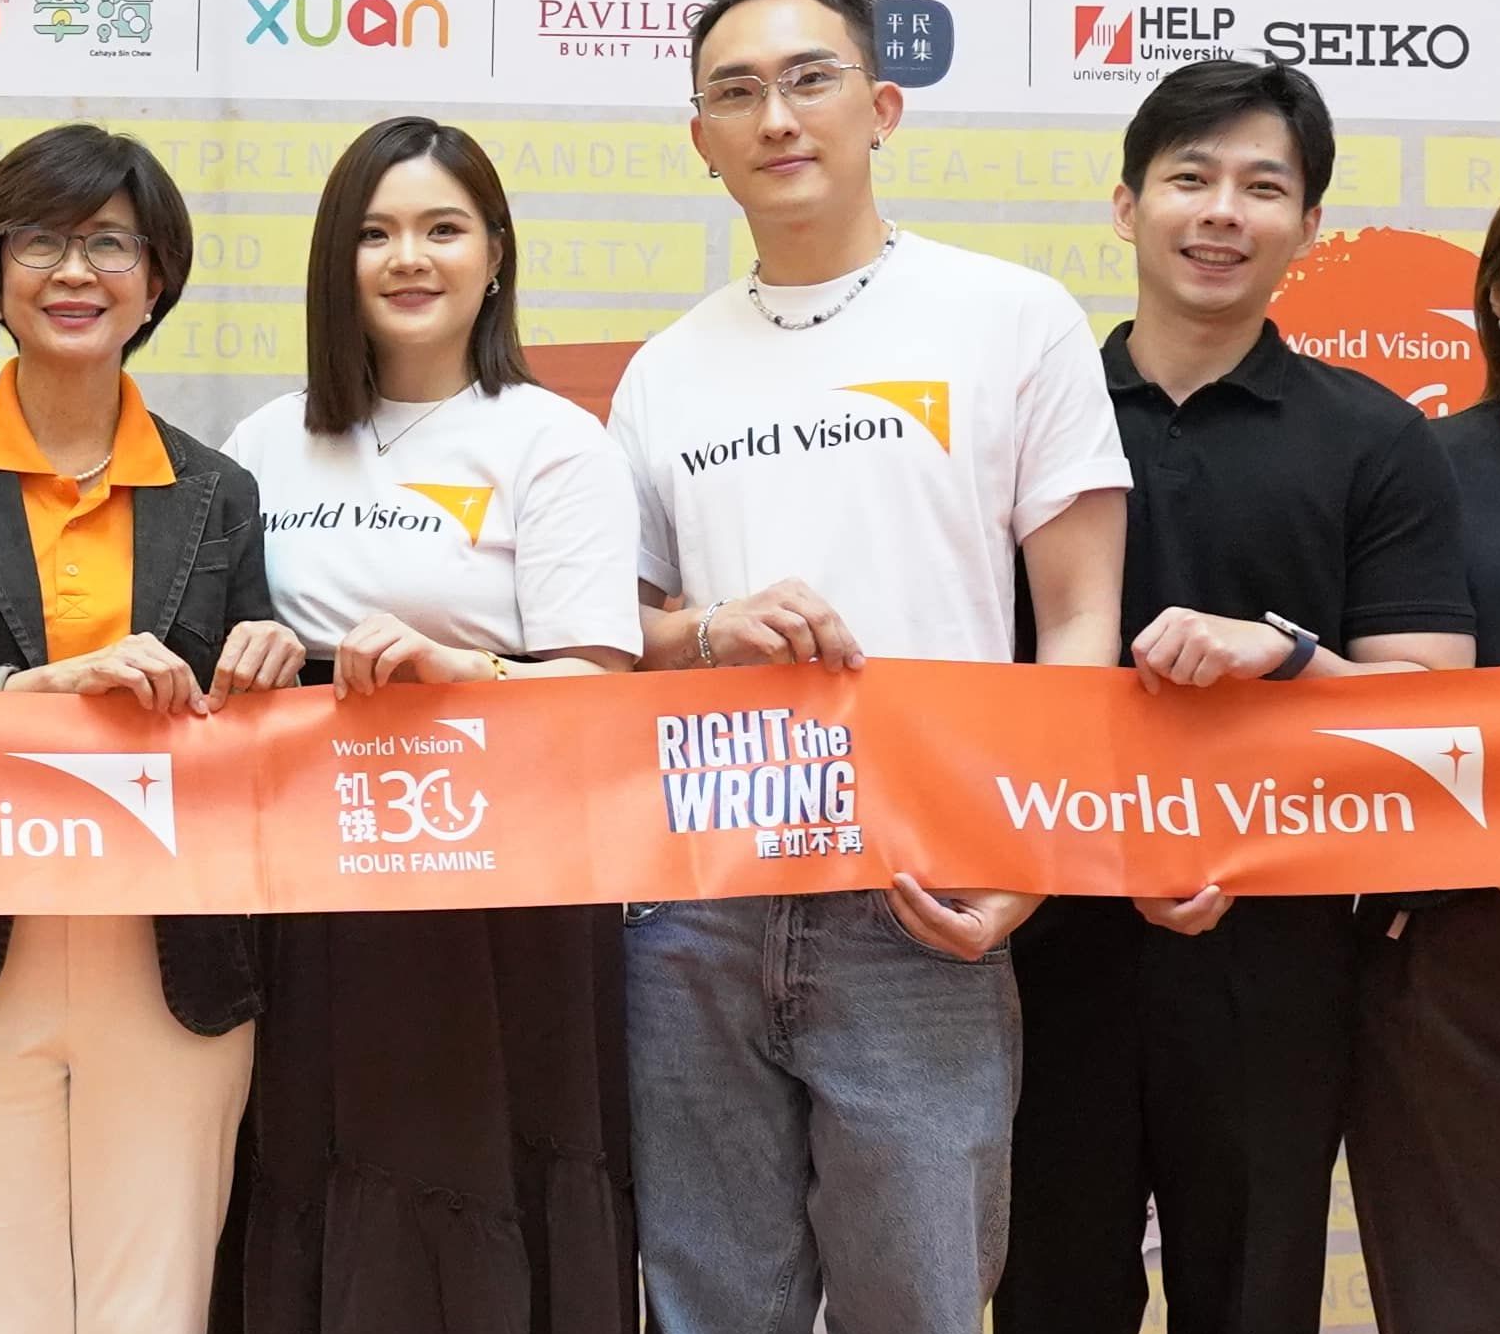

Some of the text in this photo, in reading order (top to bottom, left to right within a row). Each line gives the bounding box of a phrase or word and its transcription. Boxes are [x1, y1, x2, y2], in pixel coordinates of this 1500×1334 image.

[538, 0, 706, 31] PAVILIO
[886, 13, 931, 34] 平民
[1140, 7, 1235, 40] HELP
[560, 43, 692, 58] BUKIT JAL
[886, 38, 932, 61] 市集
[1140, 44, 1234, 61] University
[1263, 21, 1470, 69] SEIKO
[1073, 68, 1142, 84] university
[1146, 68, 1160, 82] of
[163, 139, 334, 179] TPRIN
[484, 140, 688, 179] PANDEM
[873, 147, 1112, 186] SEA-LEV
[1376, 331, 1470, 360] Vision
[680, 412, 903, 478] World Vision
[356, 501, 442, 534] Vision
[332, 736, 463, 756] World Vision
[657, 710, 851, 770] RIGHT the
[663, 762, 855, 834] WRONG
[996, 775, 1414, 836] World Vision
[340, 851, 495, 873] HOUR FAMINE
